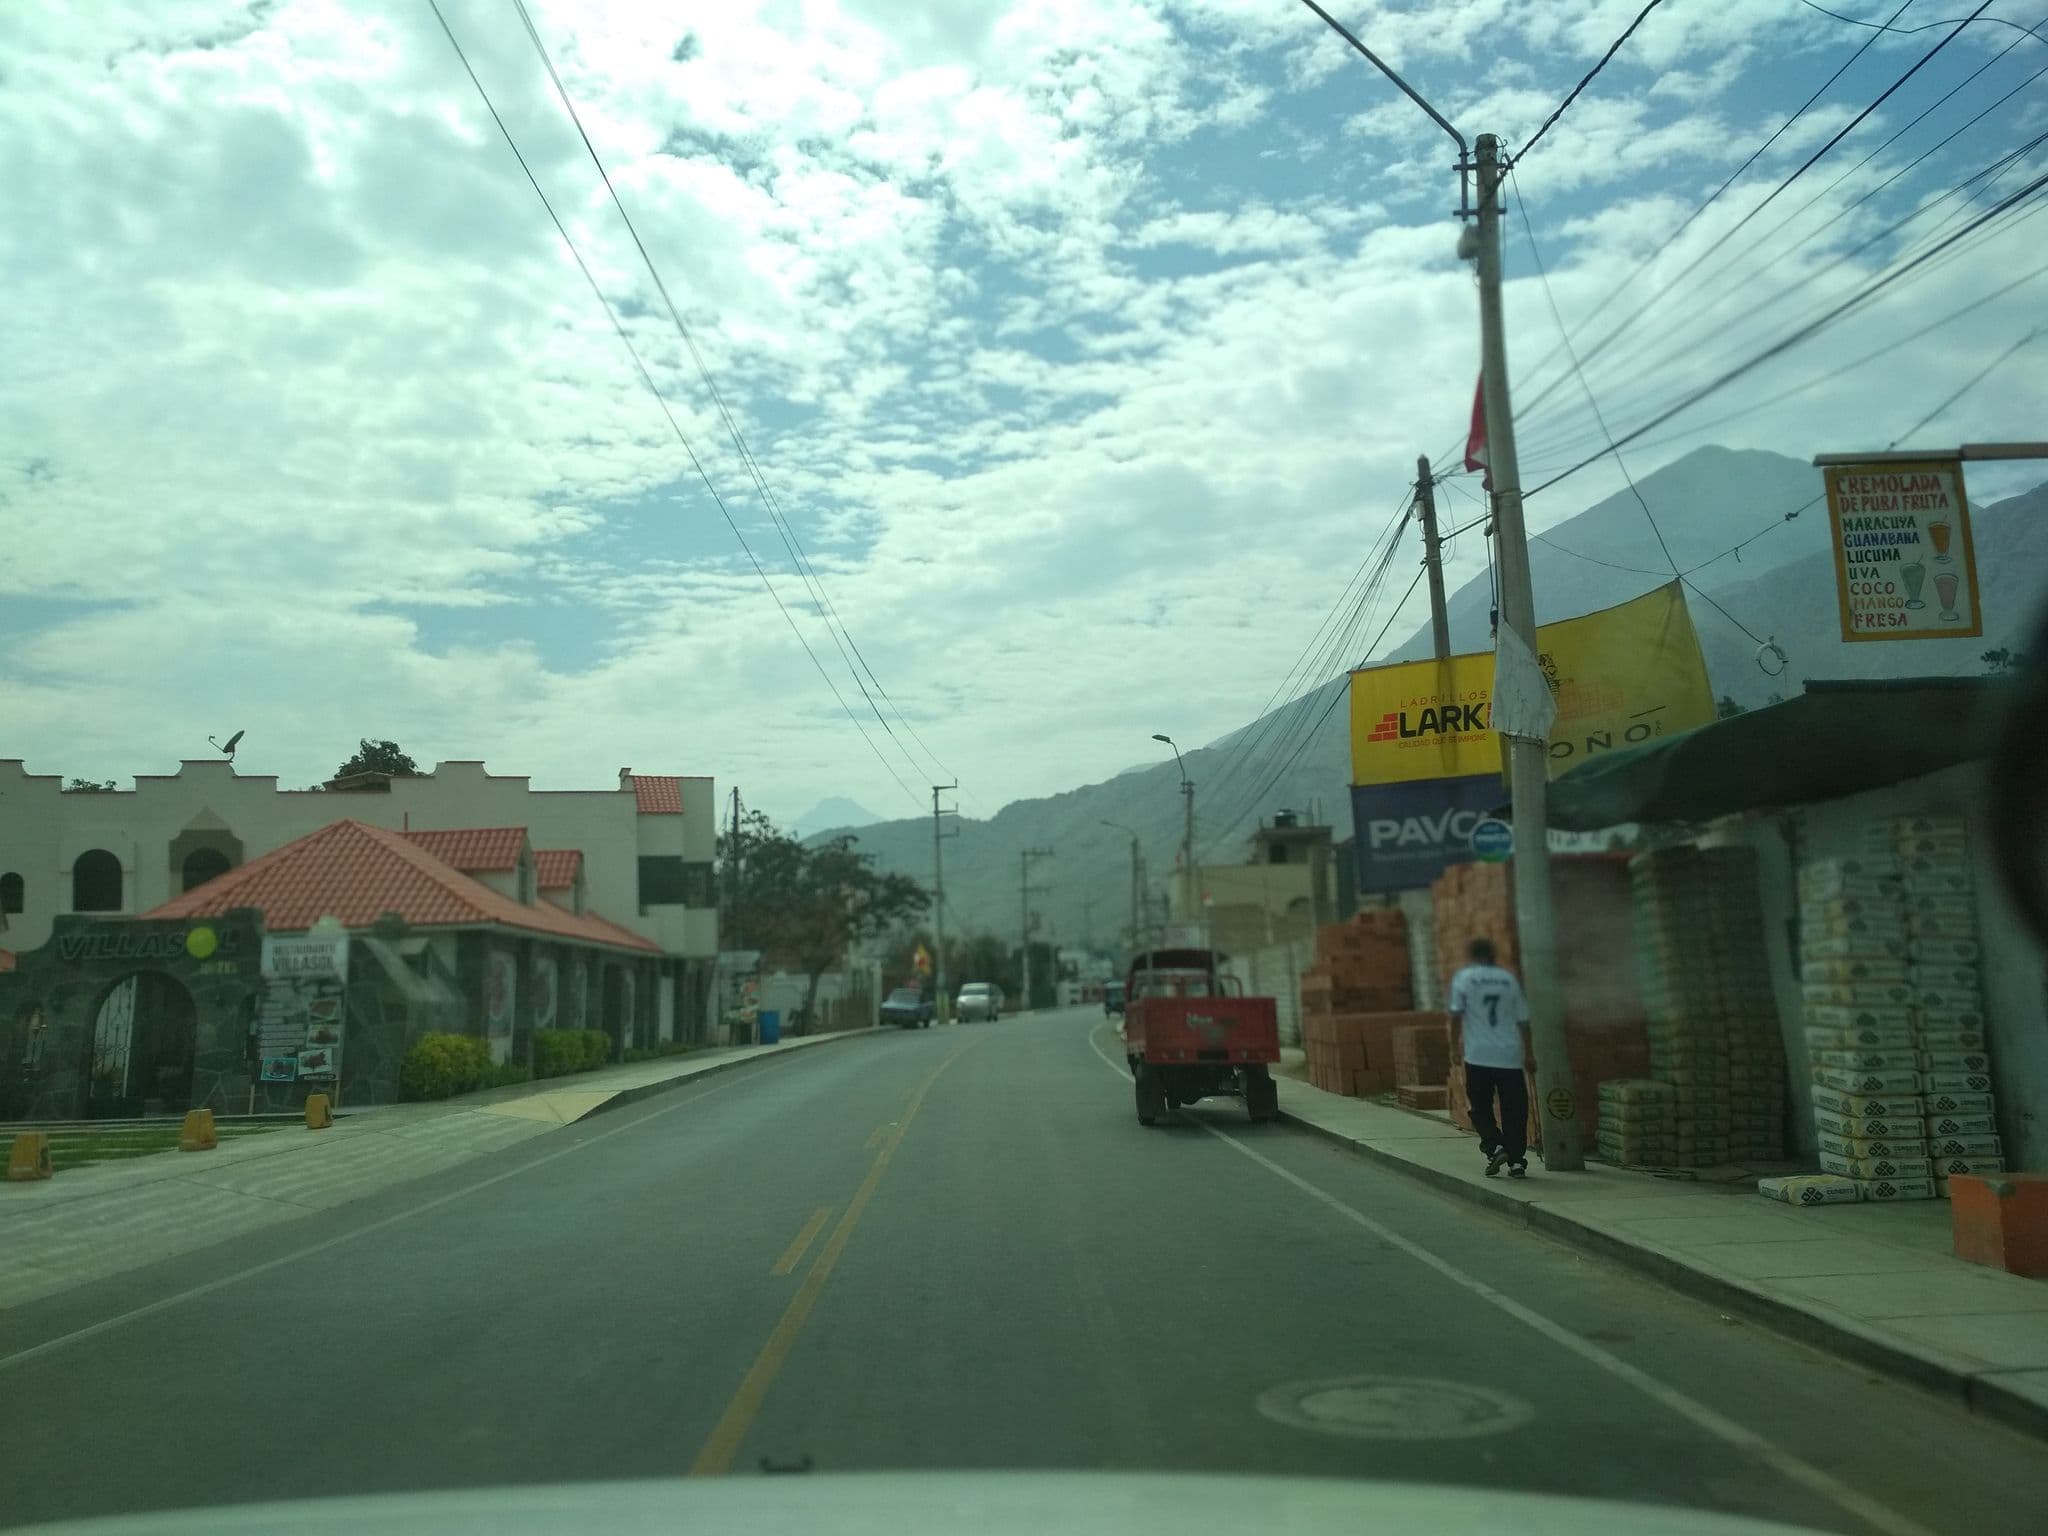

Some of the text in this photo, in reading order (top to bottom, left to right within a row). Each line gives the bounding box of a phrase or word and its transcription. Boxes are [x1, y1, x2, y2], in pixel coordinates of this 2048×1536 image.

[1836, 475, 1942, 495] CREMOLADA
[1840, 493, 1949, 513] DE PURA FRUTA
[1842, 516, 1917, 532] MARACUYA
[1844, 532, 1921, 548] GUANABANA
[1847, 548, 1901, 564] LUCUMA
[1849, 567, 1881, 580] UVA
[1850, 581, 1895, 596] COCO
[1854, 597, 1904, 610] MANGO
[1854, 612, 1908, 629] FRESA
[1400, 690, 1488, 709] LADRILLOS
[1399, 702, 1486, 739] LARK
[1398, 738, 1430, 749] CALIDAD
[1431, 736, 1447, 746] QUE
[1457, 734, 1488, 744] IMPONE
[1369, 808, 1490, 849] PAVC
[1483, 994, 1501, 1027] 7
